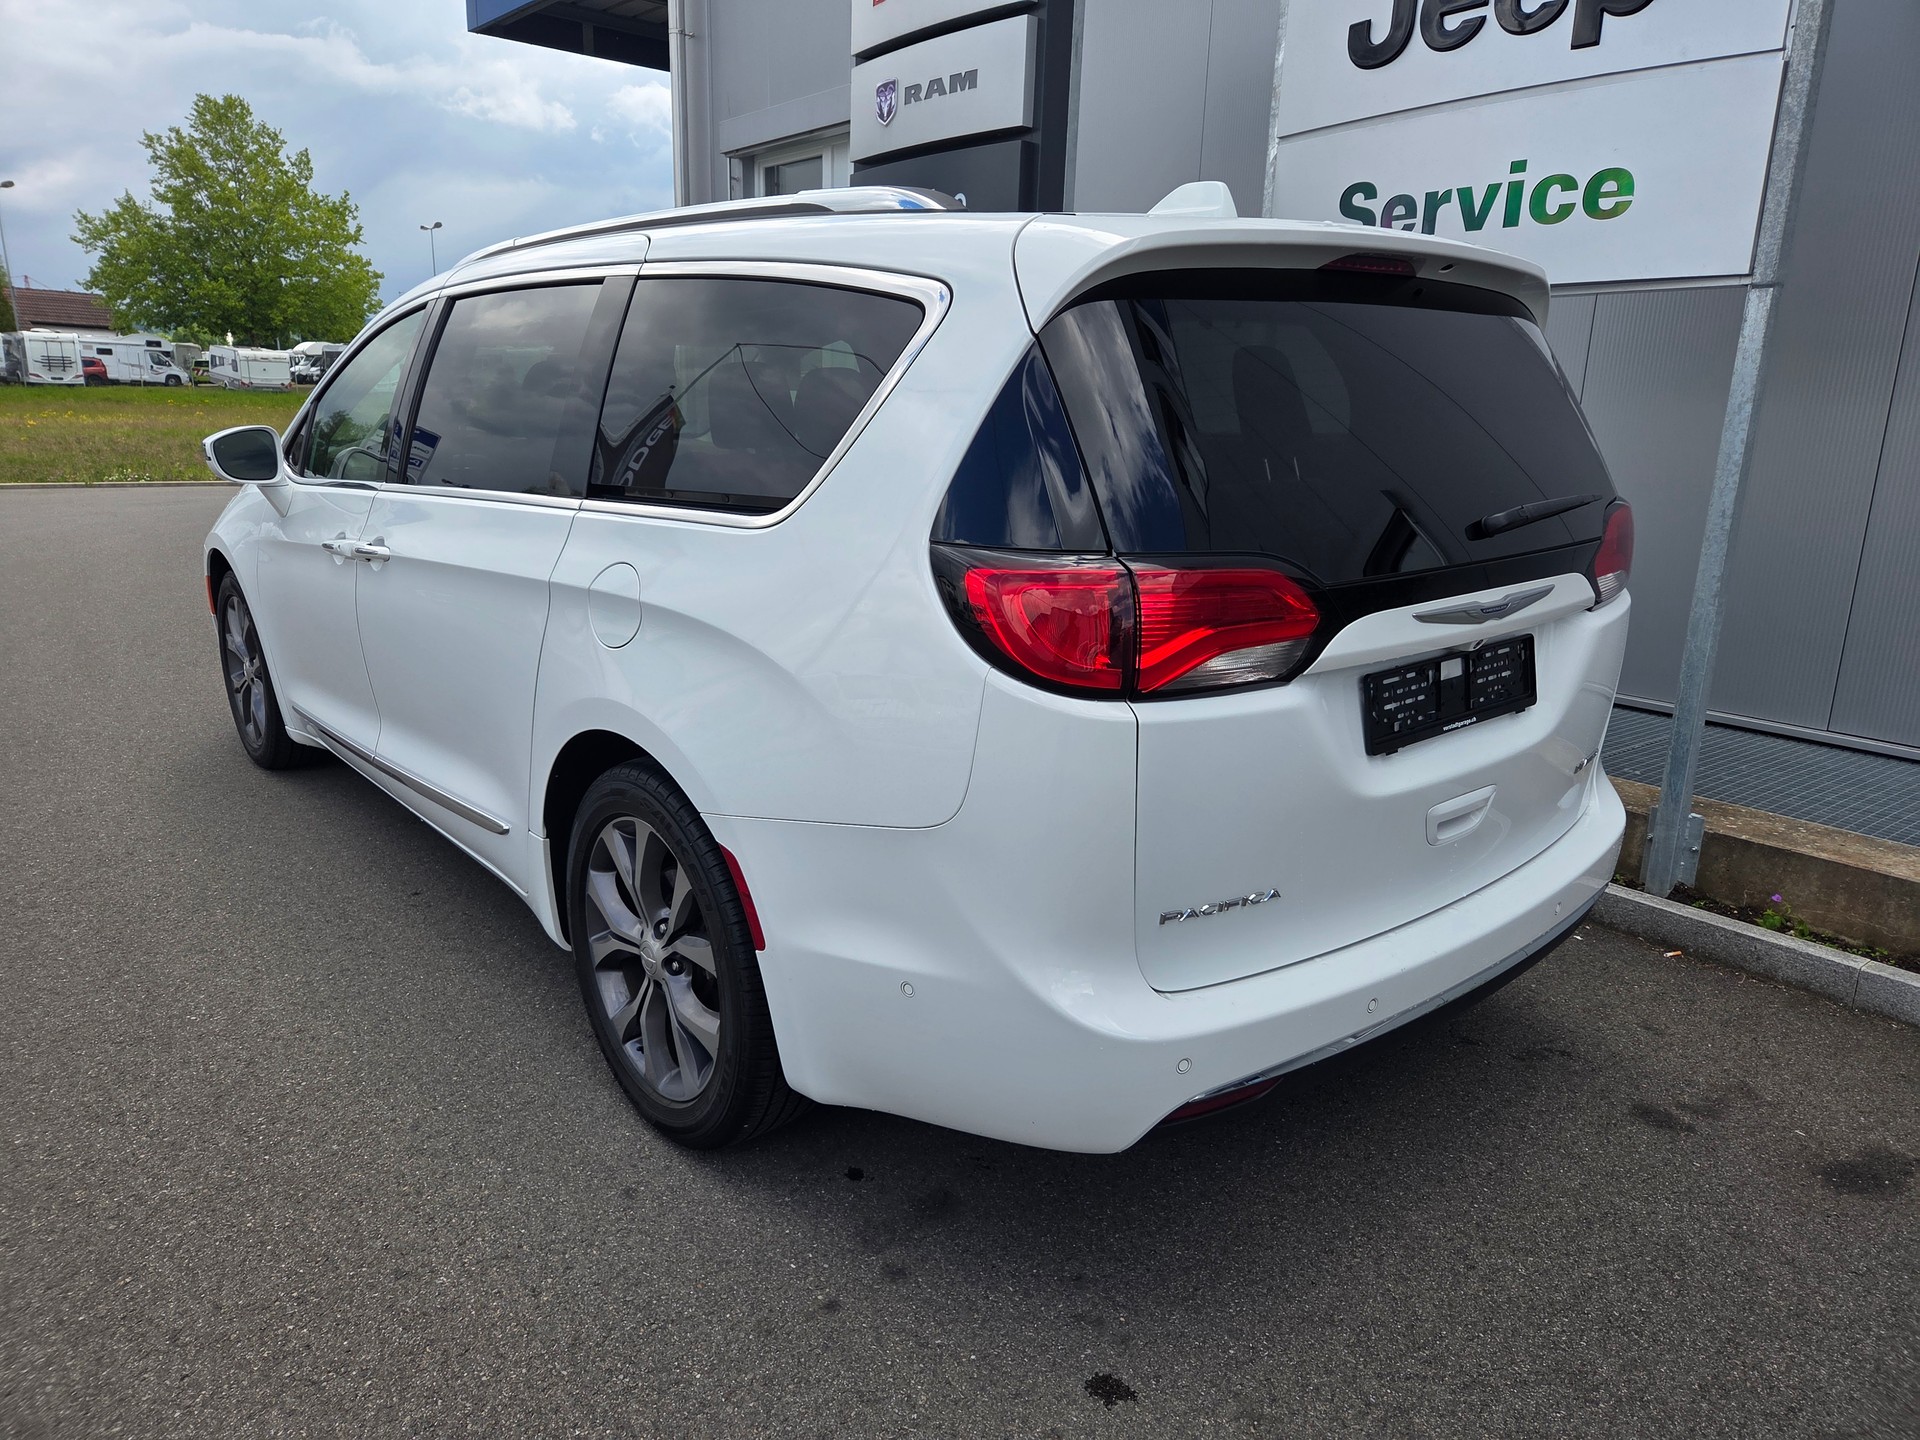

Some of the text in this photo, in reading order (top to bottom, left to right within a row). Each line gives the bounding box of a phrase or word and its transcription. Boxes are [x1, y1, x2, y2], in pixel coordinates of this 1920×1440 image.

[904, 69, 978, 106] RAM
[1339, 159, 1635, 235] Service
[1159, 888, 1281, 925] PACIFICA
